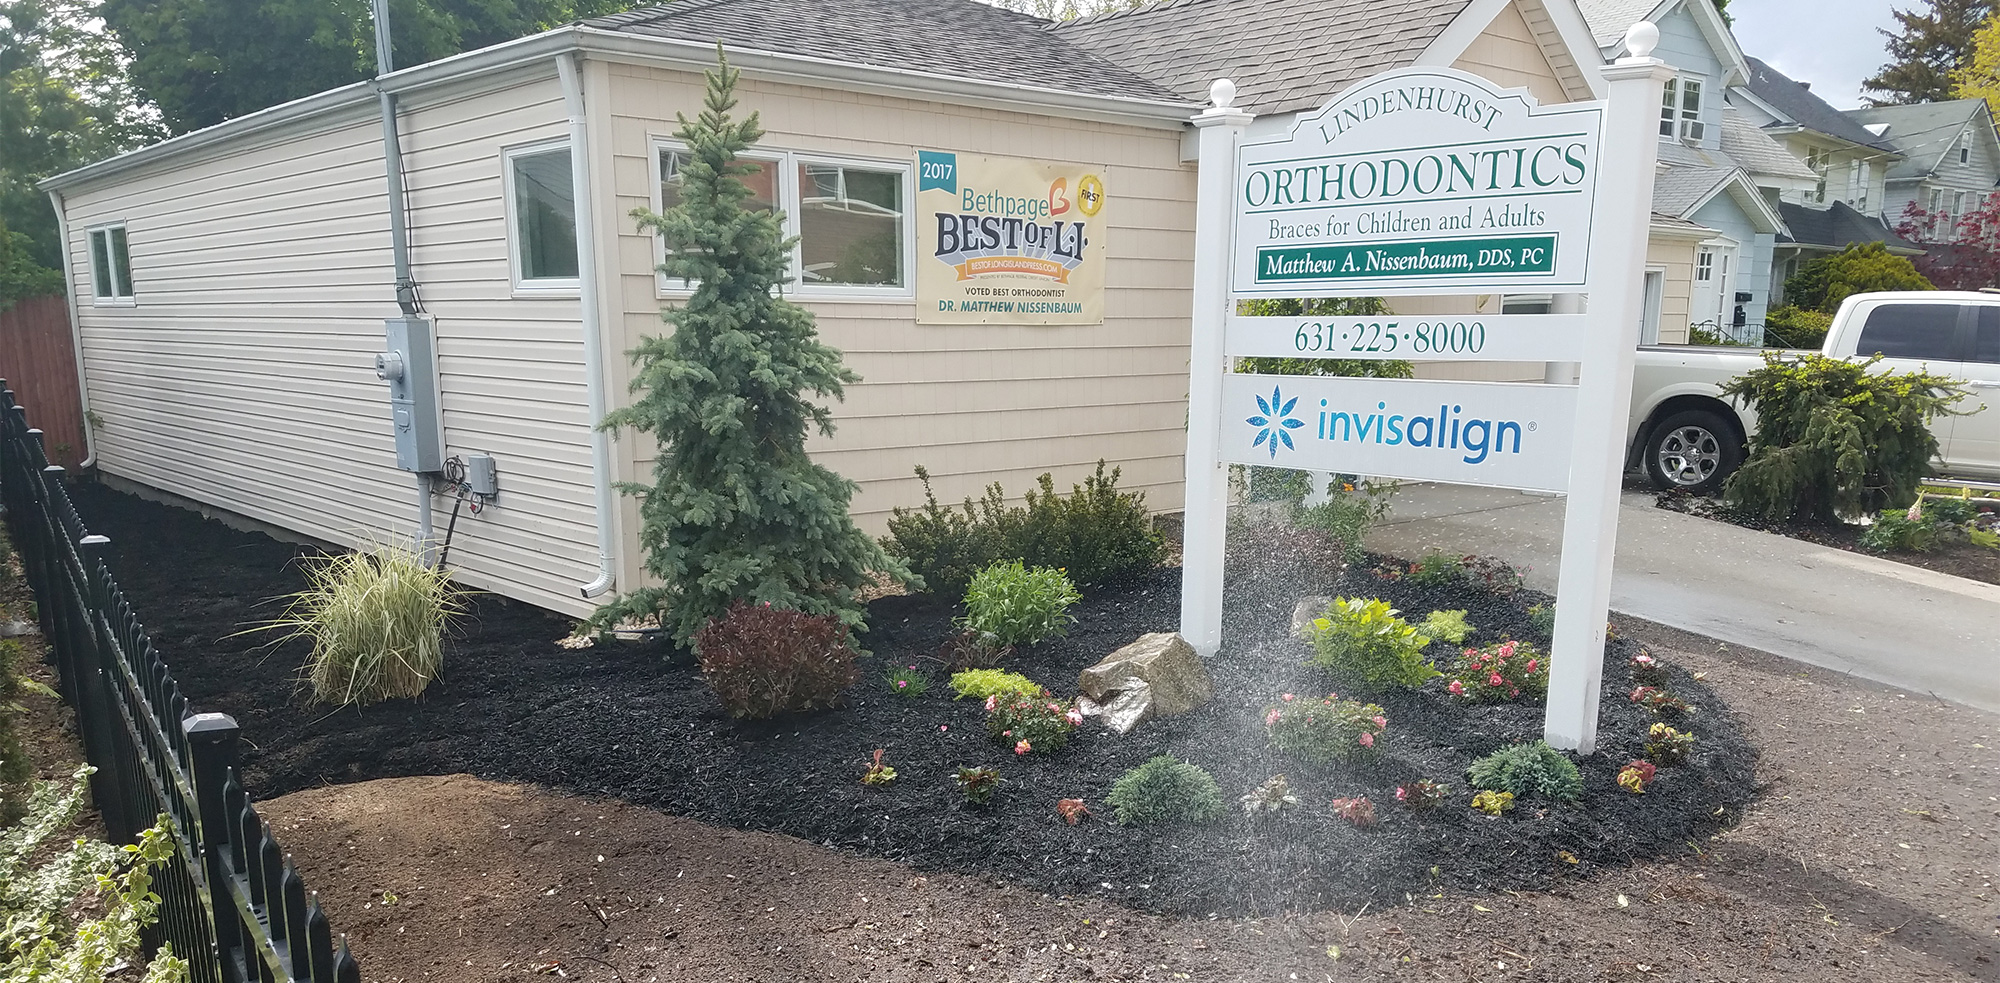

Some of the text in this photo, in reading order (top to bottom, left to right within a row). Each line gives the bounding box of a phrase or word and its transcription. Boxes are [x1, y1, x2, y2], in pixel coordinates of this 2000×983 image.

[1318, 86, 1503, 146] LINDENHURST
[922, 162, 953, 180] 2017
[1245, 142, 1588, 208] ORTHODONTICS
[962, 188, 1049, 221] Bethpage
[1081, 188, 1100, 203] FIRST
[935, 213, 1023, 257] BEST
[1025, 221, 1053, 249] OF
[1269, 202, 1546, 240] Braces for Children and Adults
[1265, 246, 1545, 275] Matthew A. Nissenbaum, DDS, PC
[938, 300, 1083, 314] DR. MATTHEW NISSENBAUM
[965, 287, 1066, 298] VOTED BEST ORTHODONTIST
